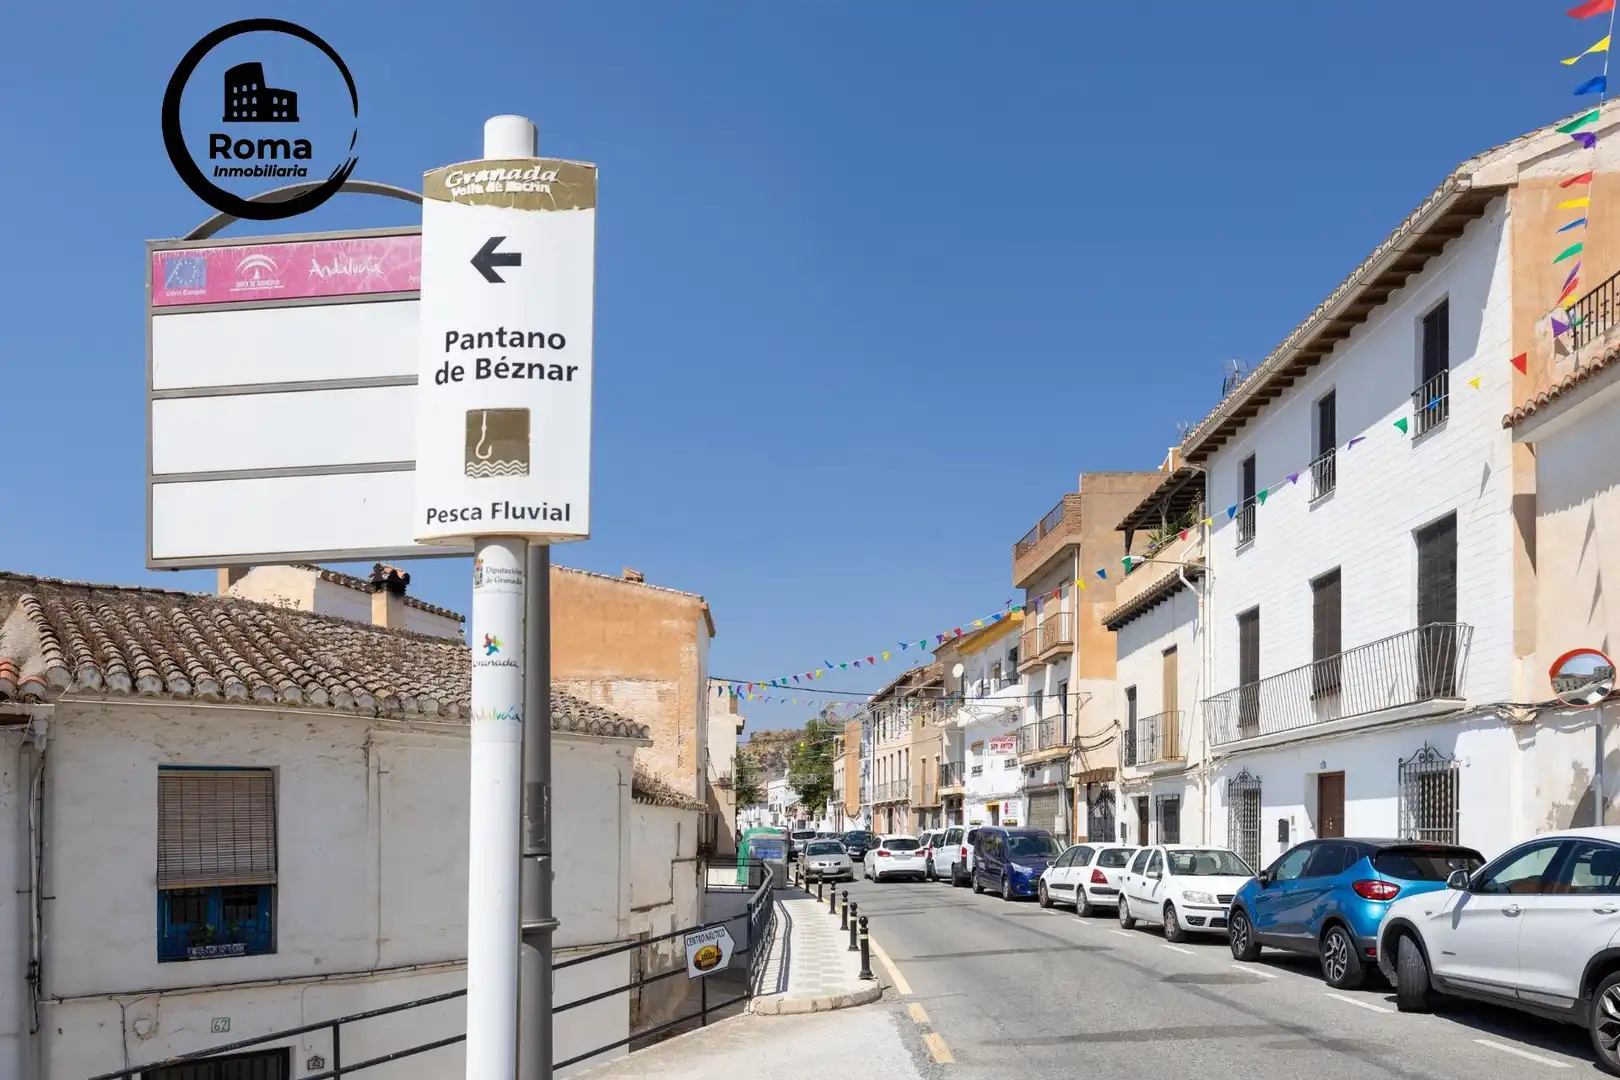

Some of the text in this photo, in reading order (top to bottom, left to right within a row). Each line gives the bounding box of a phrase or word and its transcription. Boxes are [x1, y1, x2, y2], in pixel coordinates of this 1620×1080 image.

[445, 164, 559, 188] Granada
[445, 326, 566, 353] Pantano
[435, 356, 578, 386] de Béznar
[426, 501, 570, 525] Pesca Fluvial
[213, 1019, 227, 1032] 62
